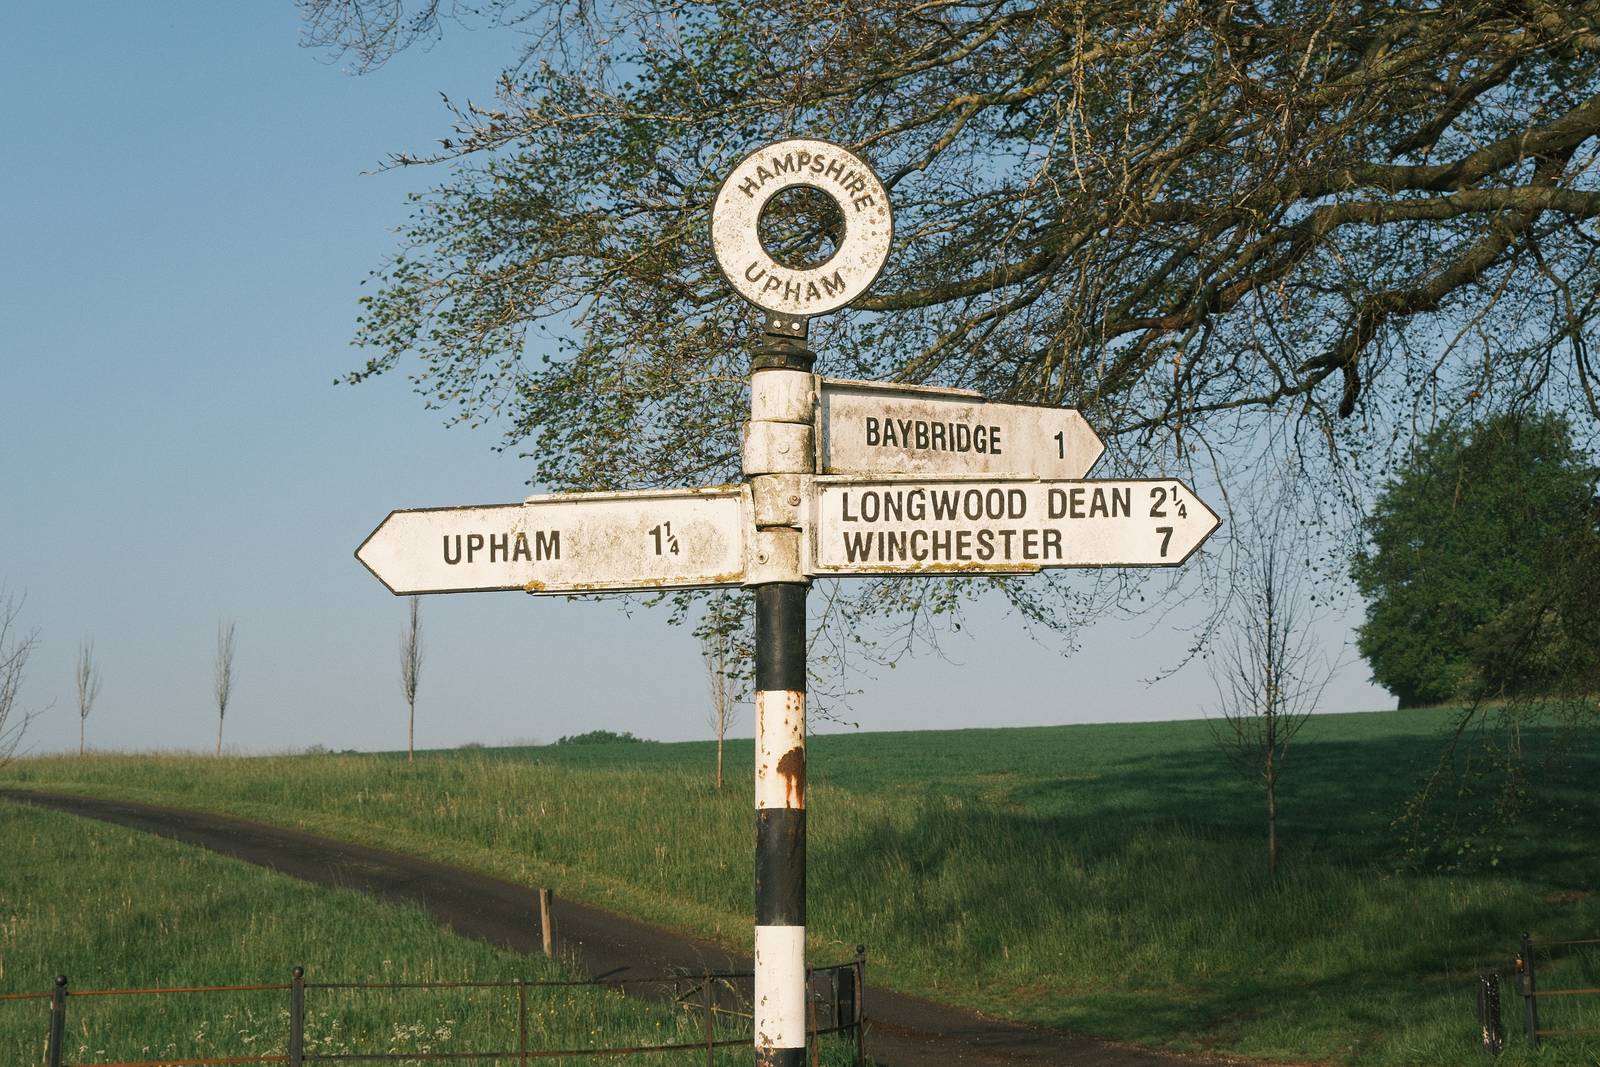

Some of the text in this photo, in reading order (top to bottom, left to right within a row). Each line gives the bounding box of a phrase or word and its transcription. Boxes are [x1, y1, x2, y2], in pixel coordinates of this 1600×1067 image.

[738, 153, 875, 212] HAMPSHIRE
[745, 261, 846, 301] UPHAM
[866, 417, 1064, 459] BAYBRIDGE 1
[842, 488, 1027, 522] LONGWOOD
[1048, 487, 1131, 519] DEAN
[443, 530, 560, 565] UPHAM
[842, 526, 1174, 562] WINCHESTER 7
